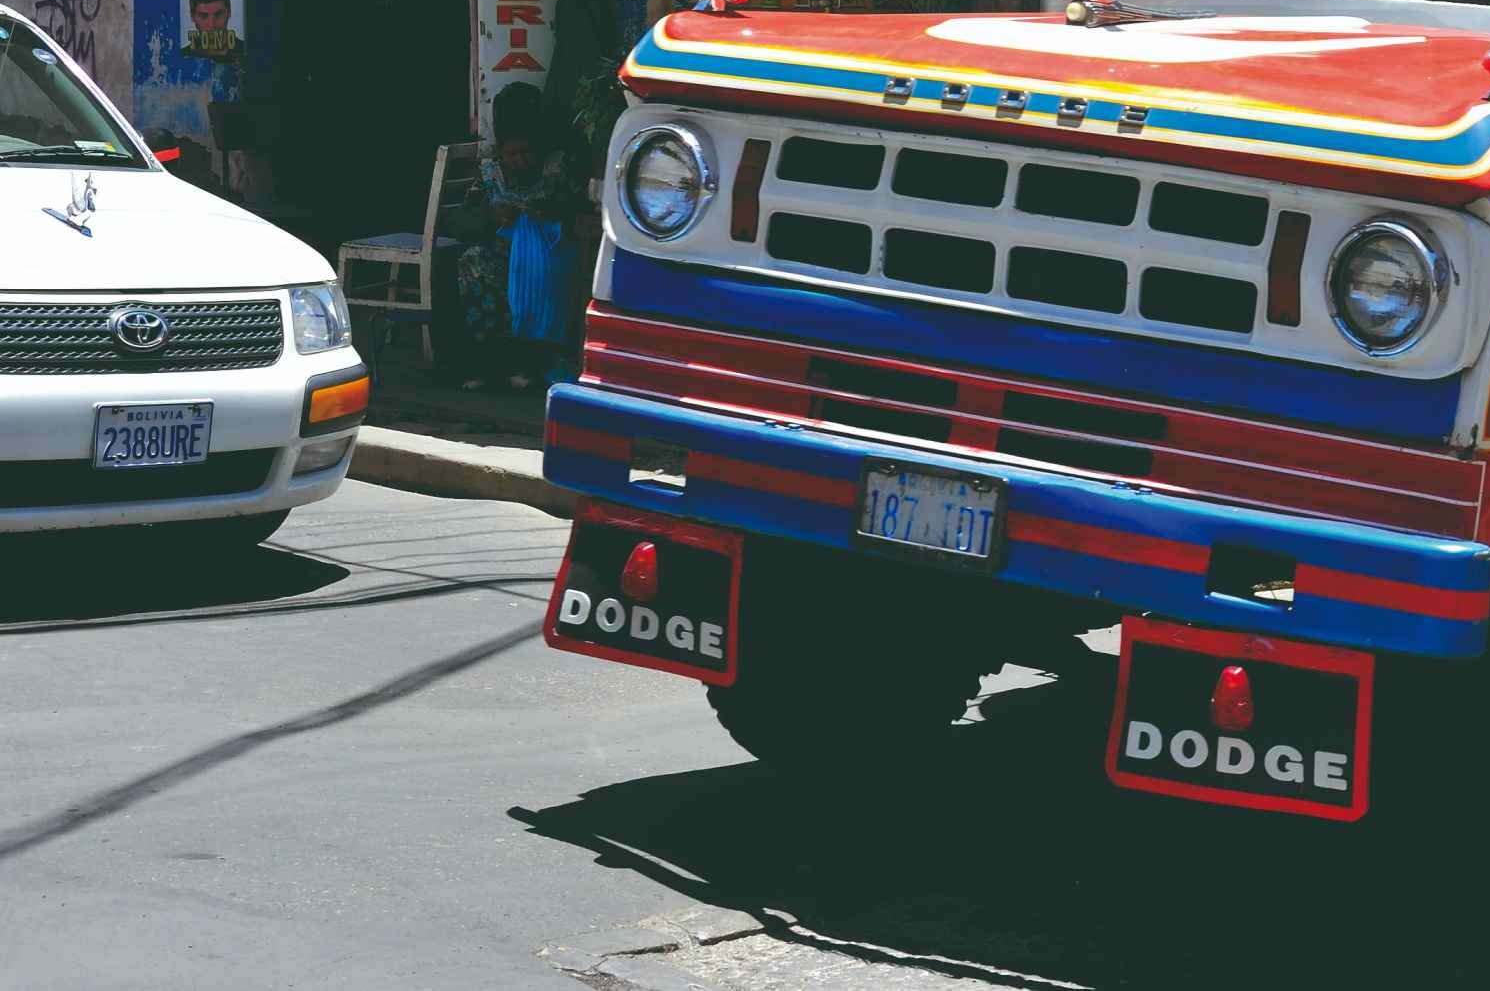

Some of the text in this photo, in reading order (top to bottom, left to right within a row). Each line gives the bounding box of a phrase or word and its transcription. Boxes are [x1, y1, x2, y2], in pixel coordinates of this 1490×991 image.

[885, 77, 1150, 123] DODGE
[128, 410, 184, 422] BOLIVIA
[102, 423, 205, 462] 2388URE
[868, 489, 919, 542] 187
[559, 588, 723, 659] DODGE
[1125, 720, 1348, 791] DODGE
